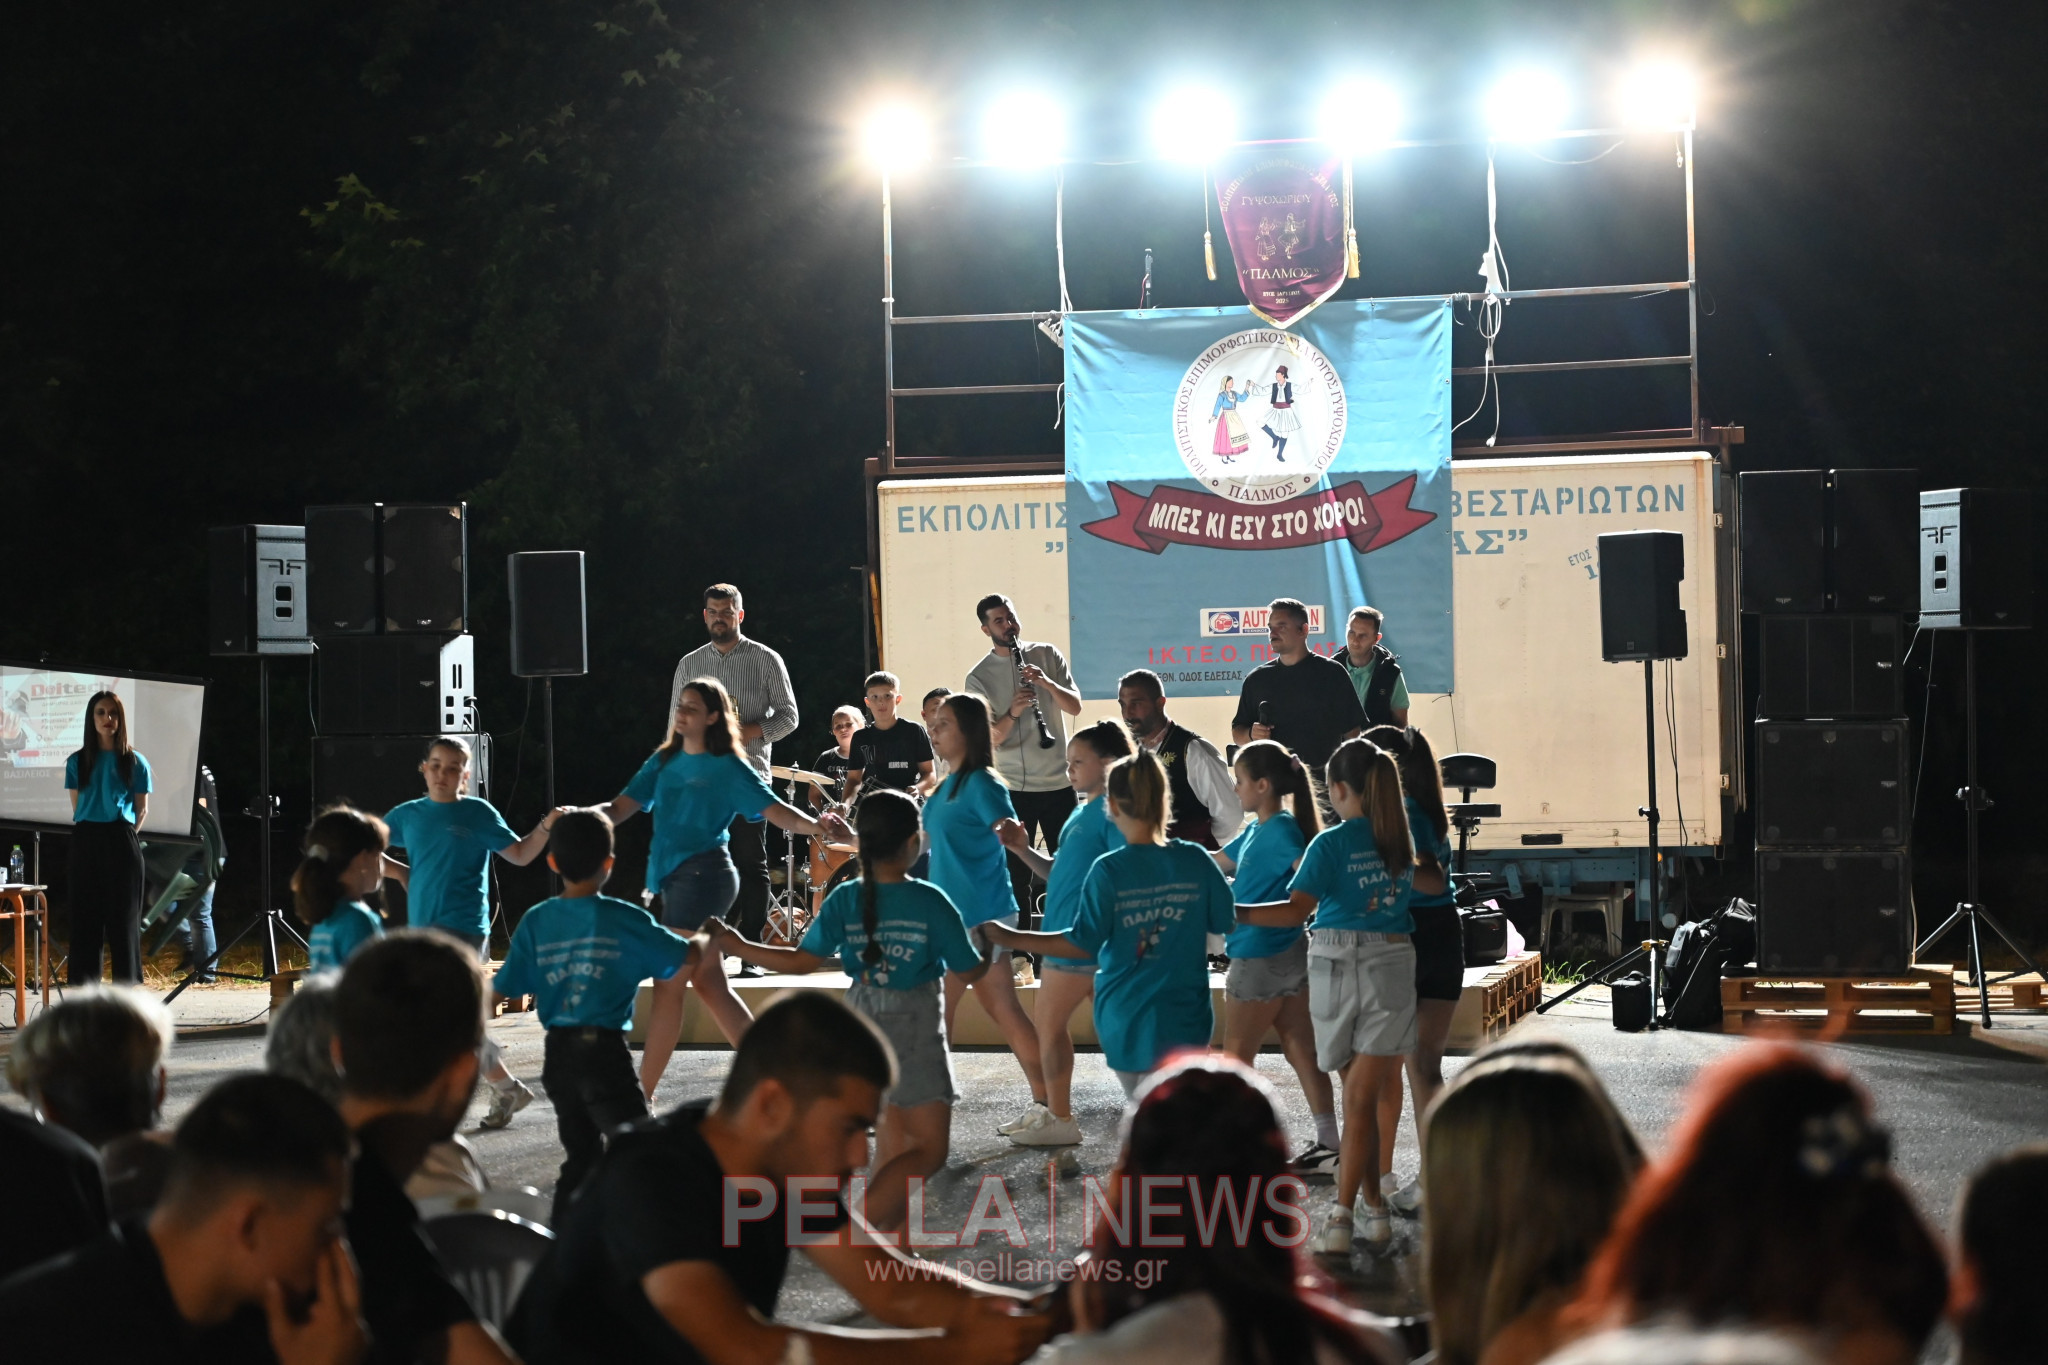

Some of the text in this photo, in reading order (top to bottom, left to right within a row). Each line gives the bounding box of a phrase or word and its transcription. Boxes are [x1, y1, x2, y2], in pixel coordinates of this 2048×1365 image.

[1241, 193, 1312, 206] ΓΥΨΟΧΩΡΙΟΥ
[1187, 331, 1287, 387] ΕΠΙΜΟΡΦΩΤΙΚΟΣ
[1227, 481, 1297, 502] ΠΑΛΜΟΣ
[1148, 496, 1368, 541] ΜΠΕΣ ΚΙ ΕΣΥ ΣΤΟ ΧΟΡΟ!
[1568, 549, 1592, 567] ΕΤΟΣ
[1179, 671, 1202, 682] ΟΔΟΣ
[1205, 670, 1243, 681] ΕΔΕΣΣΑΣ
